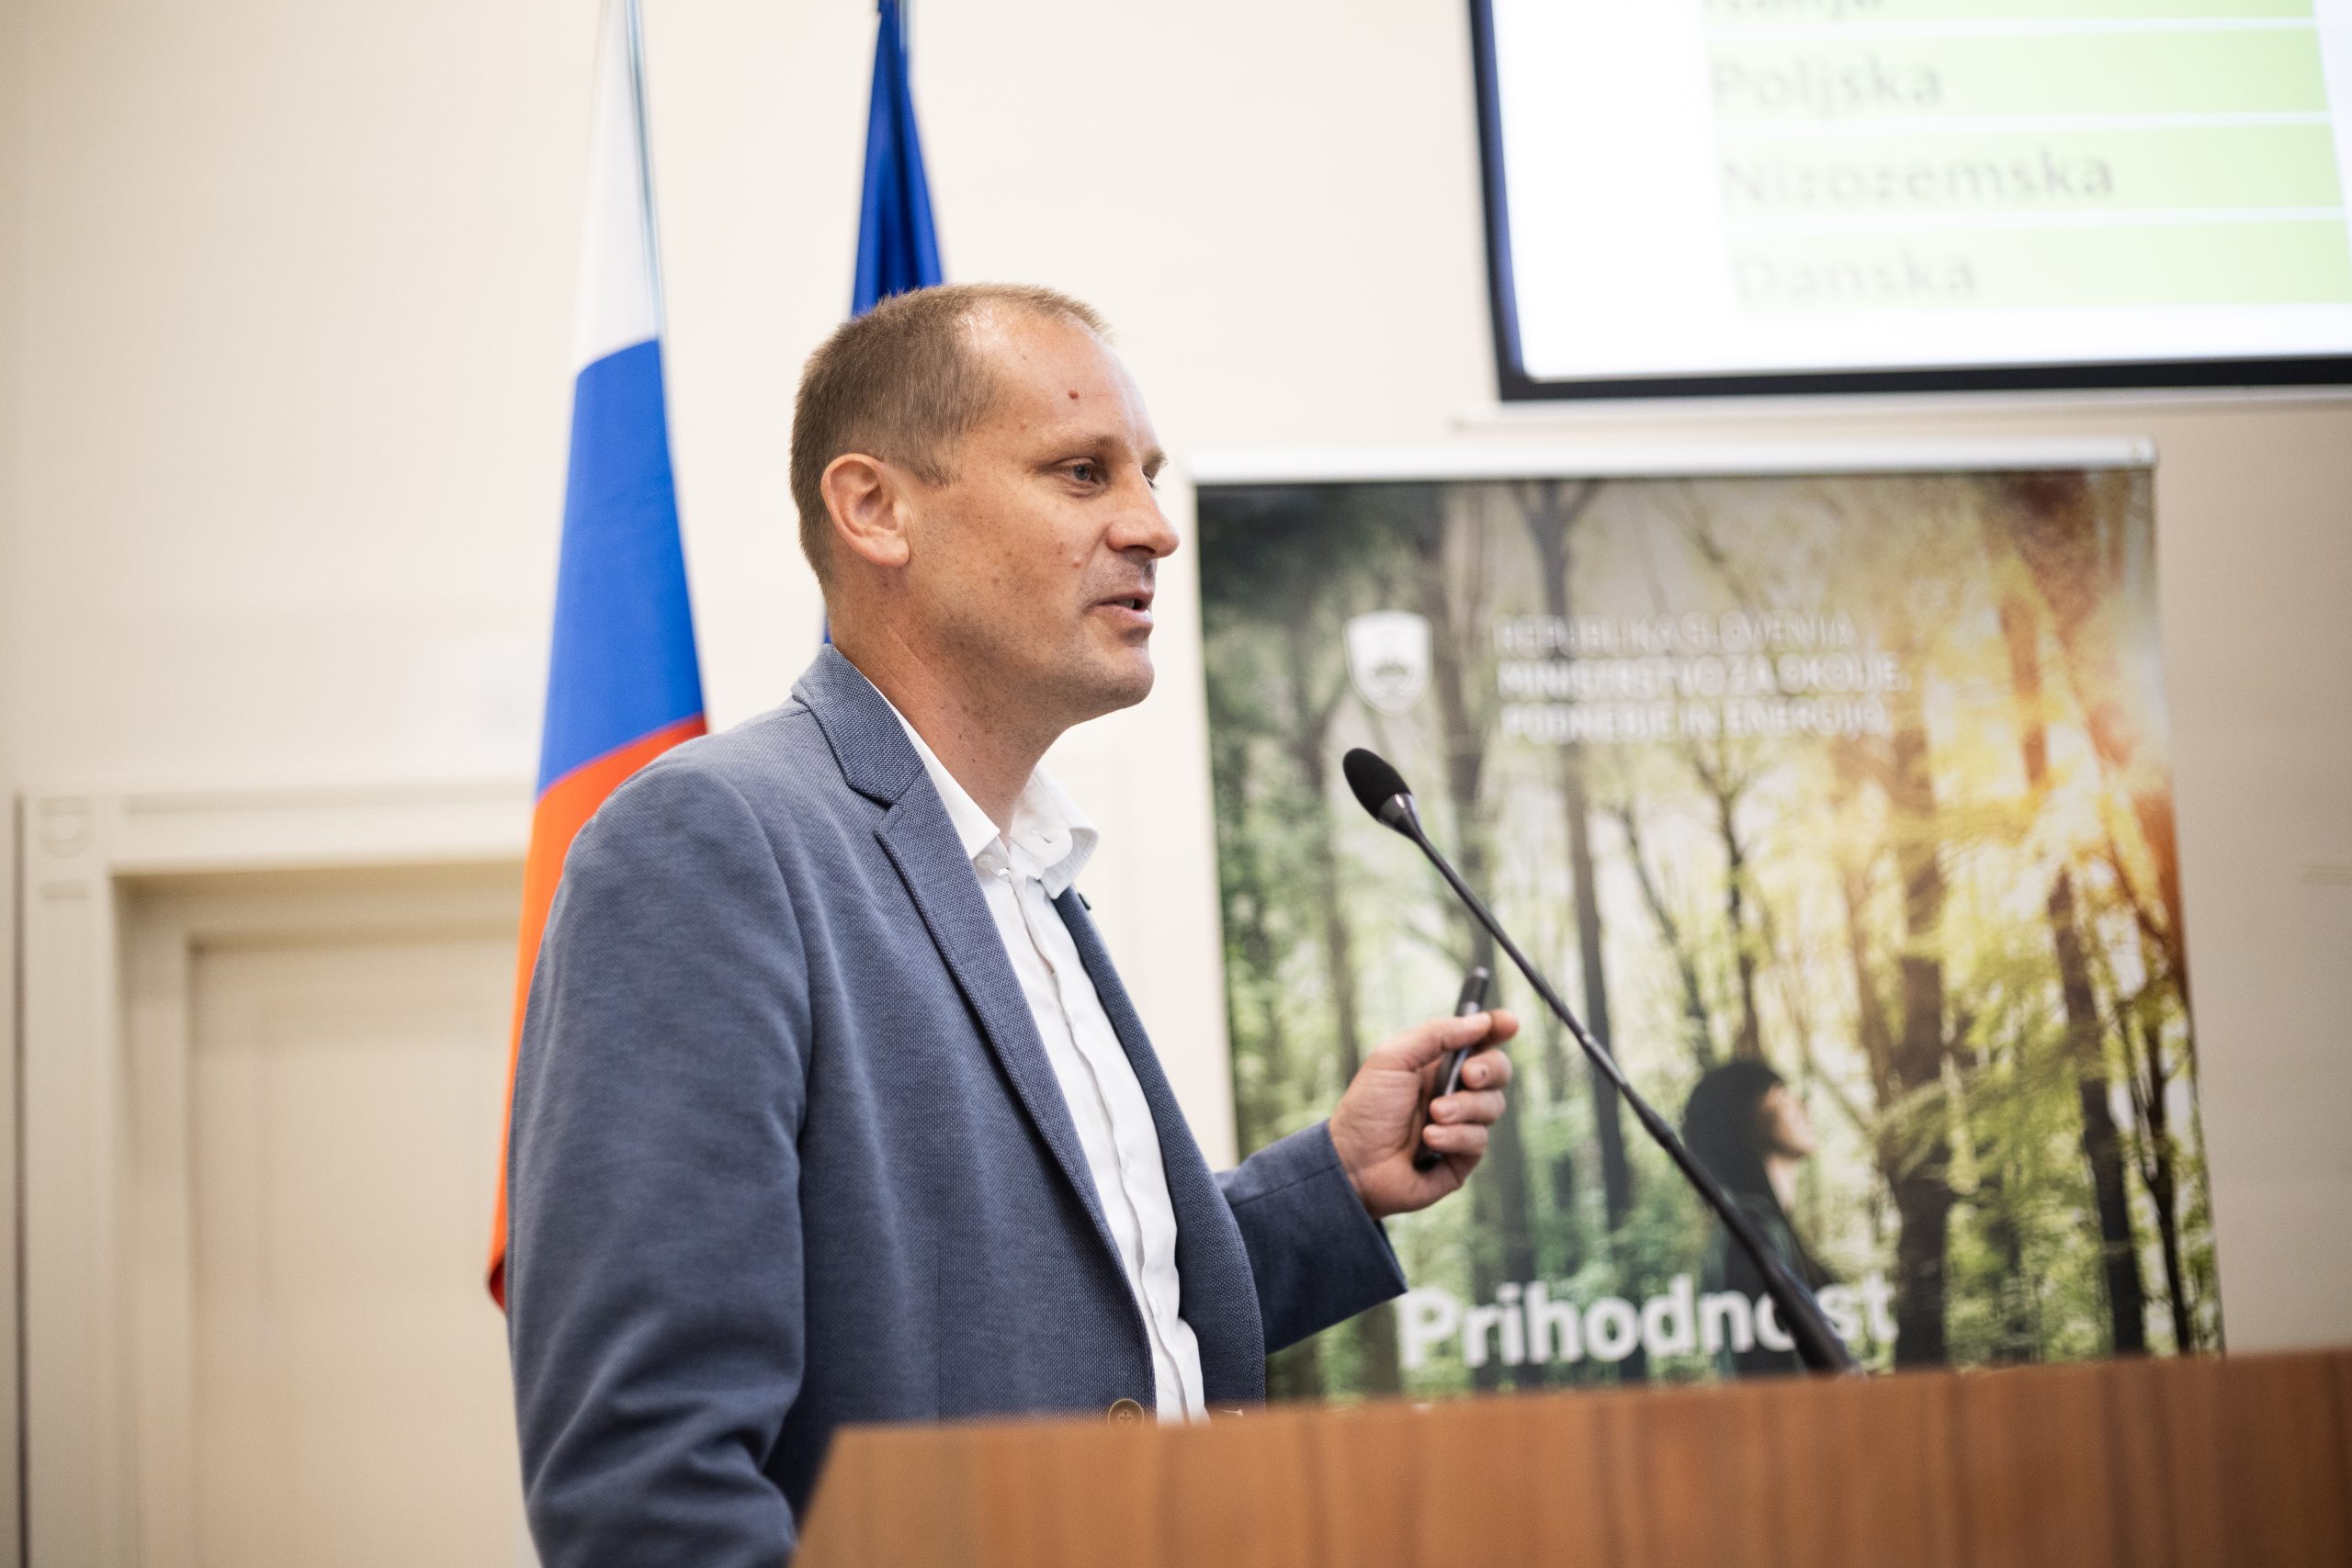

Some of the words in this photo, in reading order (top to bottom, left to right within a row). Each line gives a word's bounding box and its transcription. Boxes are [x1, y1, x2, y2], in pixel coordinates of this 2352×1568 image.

[1712, 51, 1943, 118] Poljska
[1721, 146, 2116, 209] Nizozemska
[1734, 243, 1978, 304] Danska
[1397, 1273, 1899, 1369] Prihodnost
